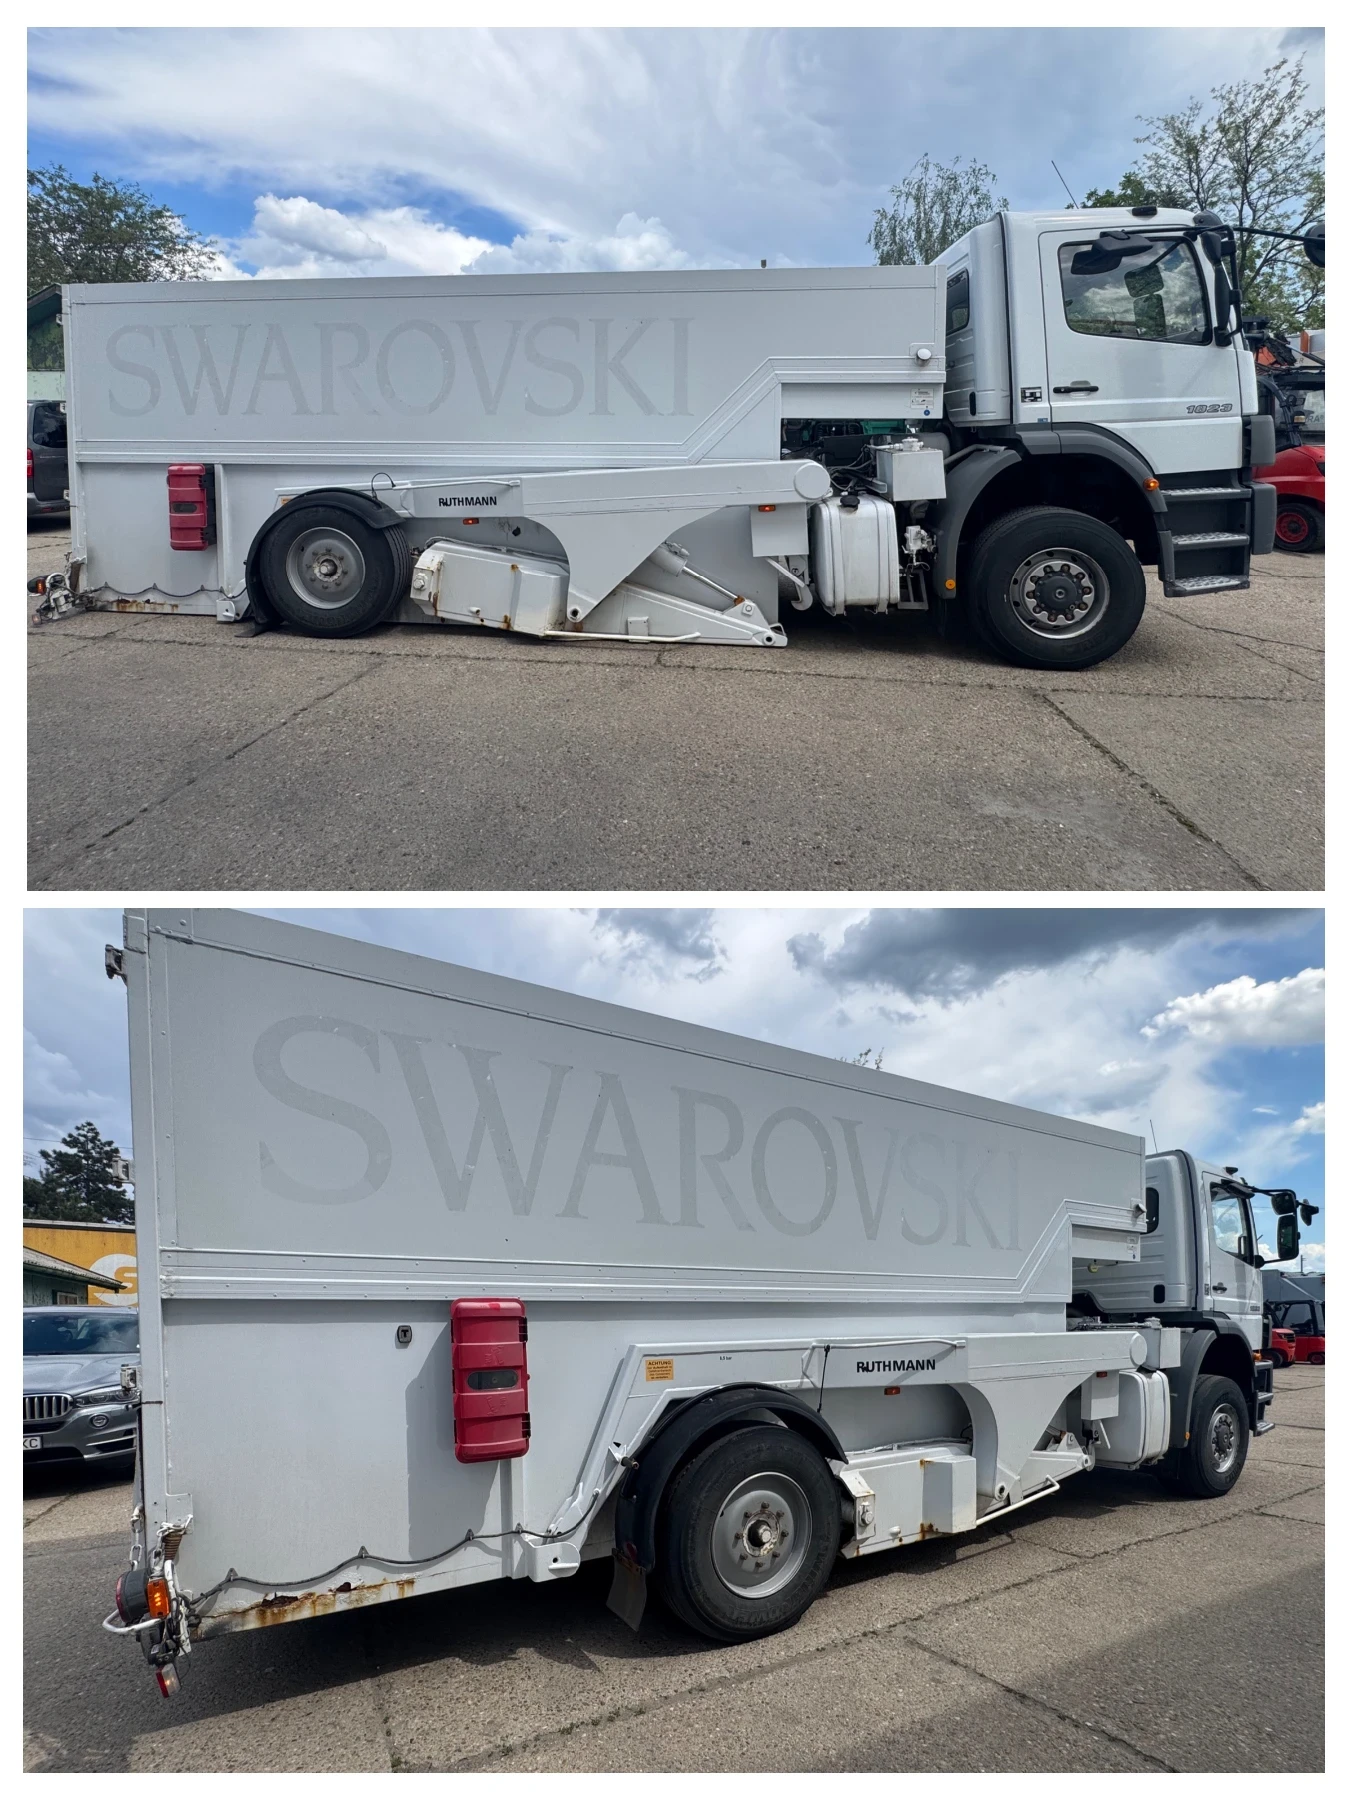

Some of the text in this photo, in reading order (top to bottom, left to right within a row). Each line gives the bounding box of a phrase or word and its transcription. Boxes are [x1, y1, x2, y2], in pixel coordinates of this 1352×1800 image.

[105, 317, 695, 417] SWAROVSKI
[438, 496, 497, 507] RUTHMANN
[252, 1014, 1022, 1251] SWAROVSKI
[856, 1359, 936, 1373] RUTHMANN
